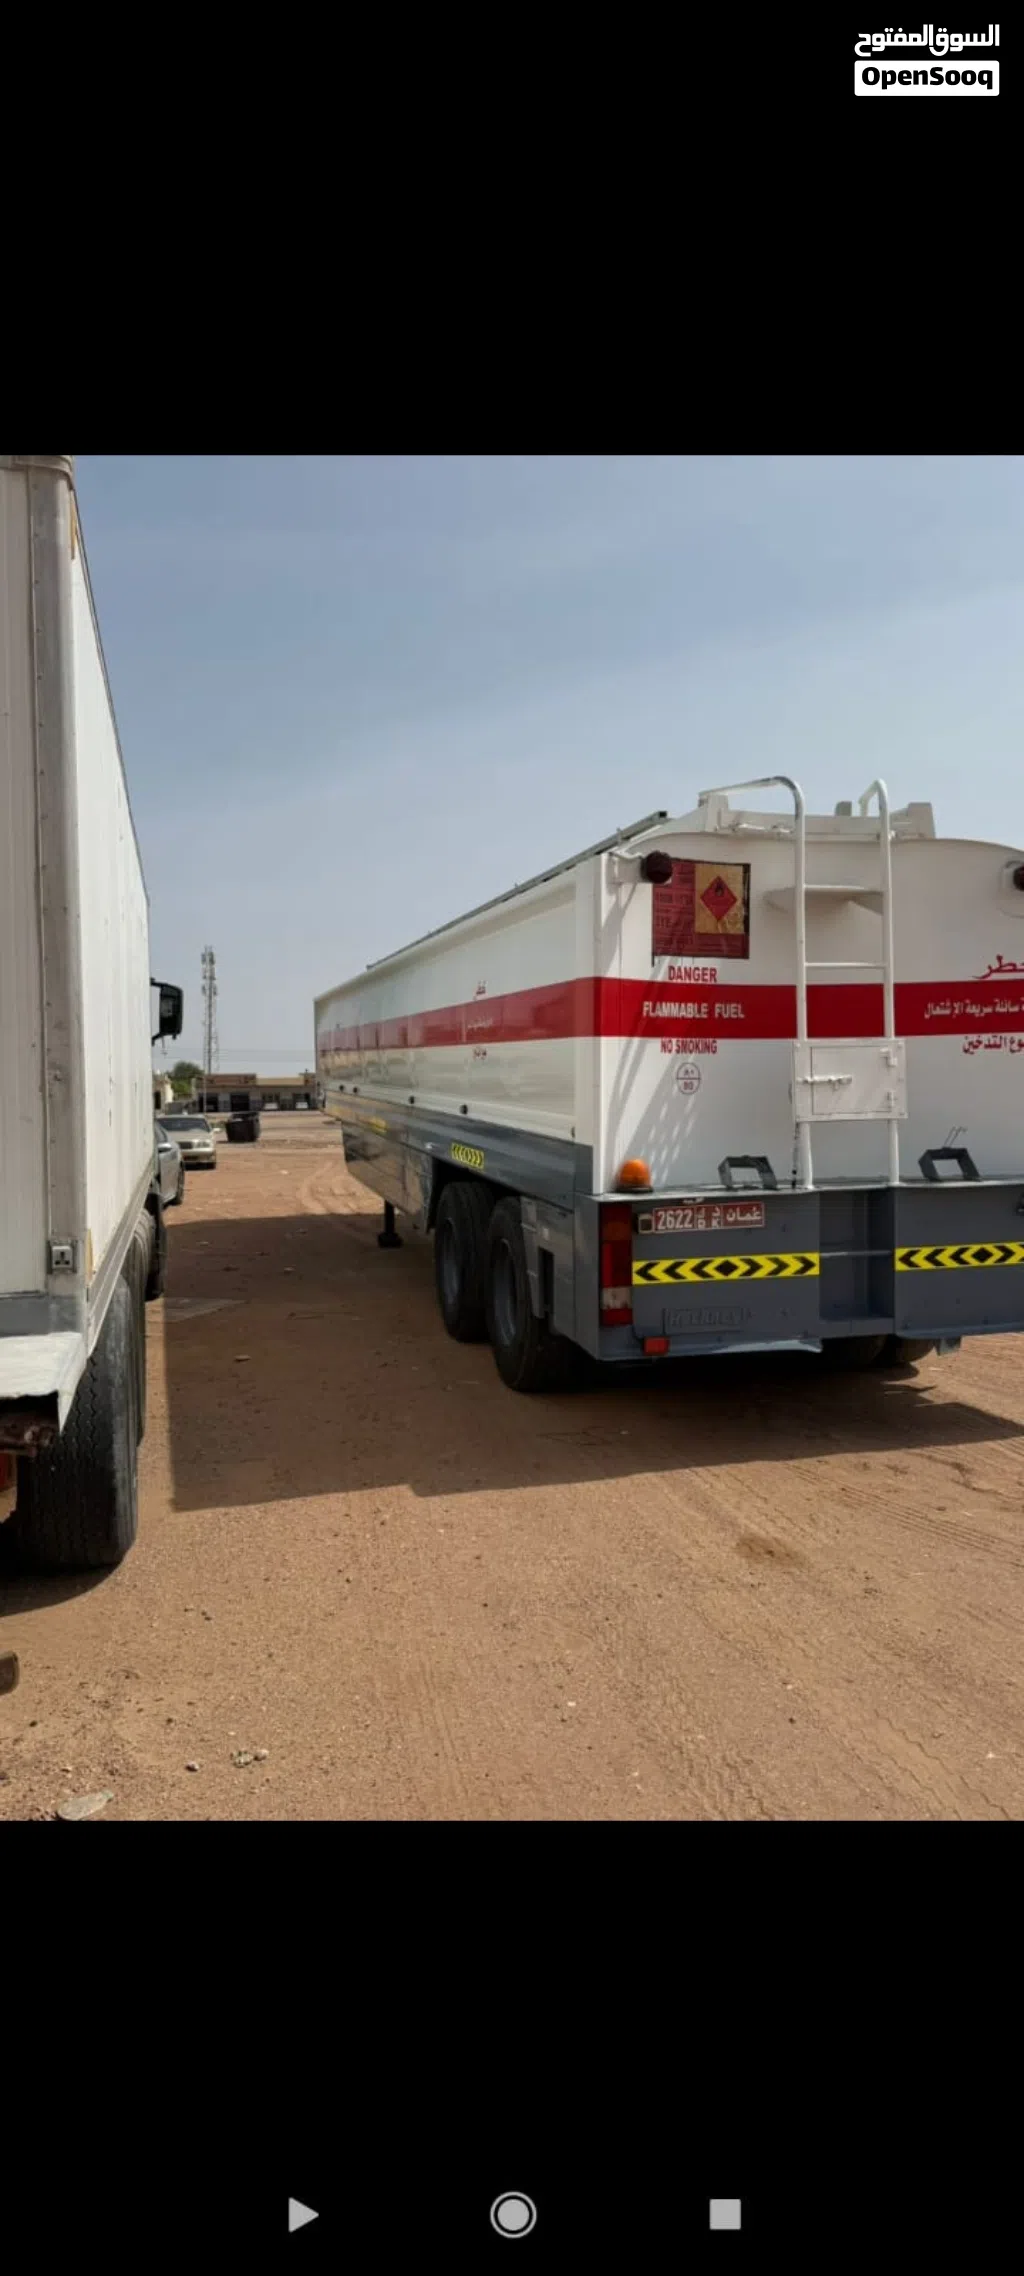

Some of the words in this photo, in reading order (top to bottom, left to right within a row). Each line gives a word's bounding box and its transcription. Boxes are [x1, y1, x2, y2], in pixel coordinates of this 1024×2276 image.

[667, 965, 718, 983] DANGER
[970, 954, 1024, 979] طر
[642, 1001, 709, 1018] FLAMMABLE
[714, 1003, 745, 1018] FUEL
[660, 1039, 673, 1053] NO
[675, 1039, 718, 1054] SMOKING
[962, 1034, 1007, 1055] التدخين
[656, 1206, 693, 1230] 2622
